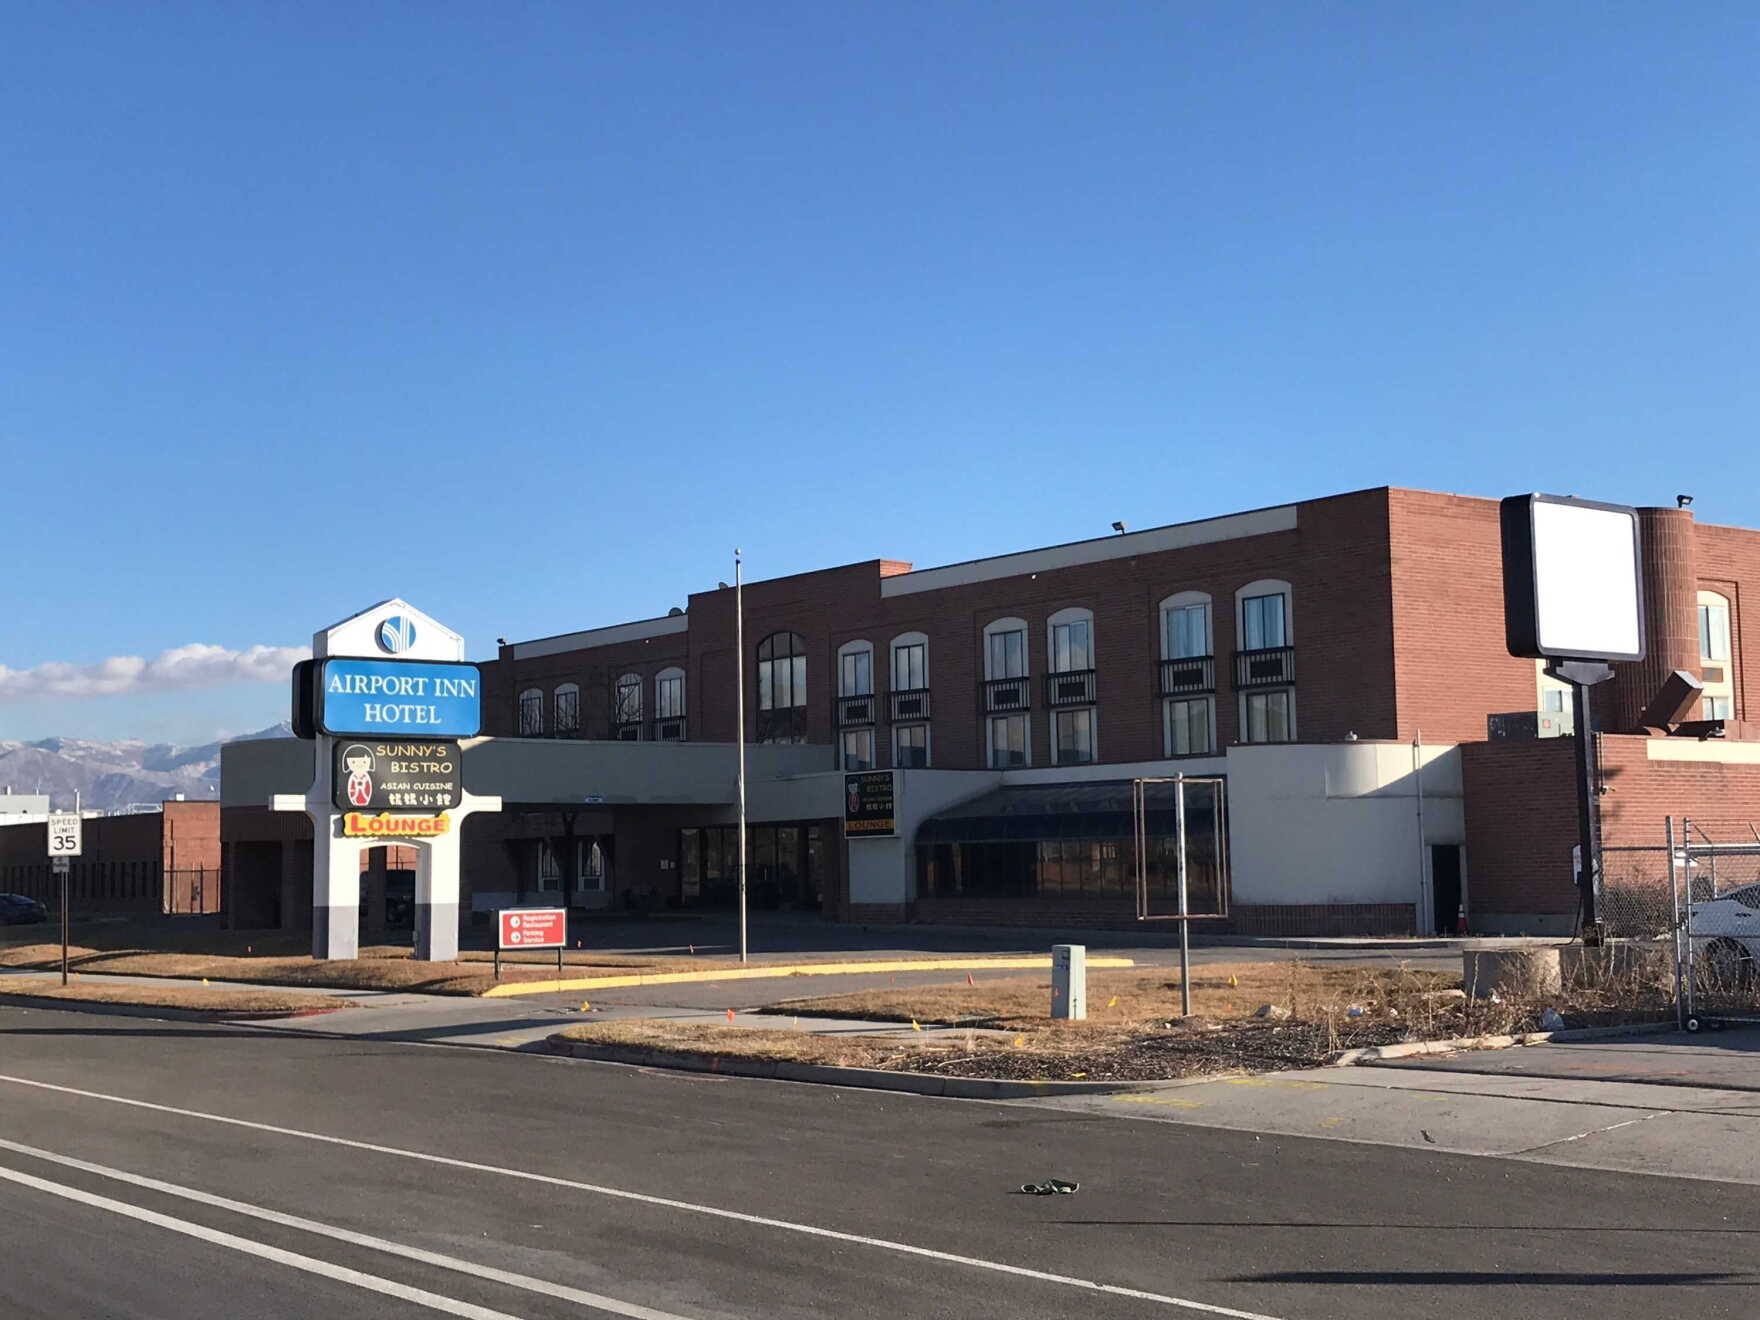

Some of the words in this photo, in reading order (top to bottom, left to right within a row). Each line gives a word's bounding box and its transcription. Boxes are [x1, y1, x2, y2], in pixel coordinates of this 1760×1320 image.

[328, 674, 428, 696] AIRPORT
[434, 678, 476, 698] INN
[364, 703, 441, 724] HOTEL
[376, 745, 447, 757] SUNNY'S
[391, 761, 453, 773] BISTRO
[380, 782, 411, 790] ASIAN
[413, 782, 453, 790] CUISINE
[51, 818, 78, 826] SPEED
[53, 836, 76, 851] 35
